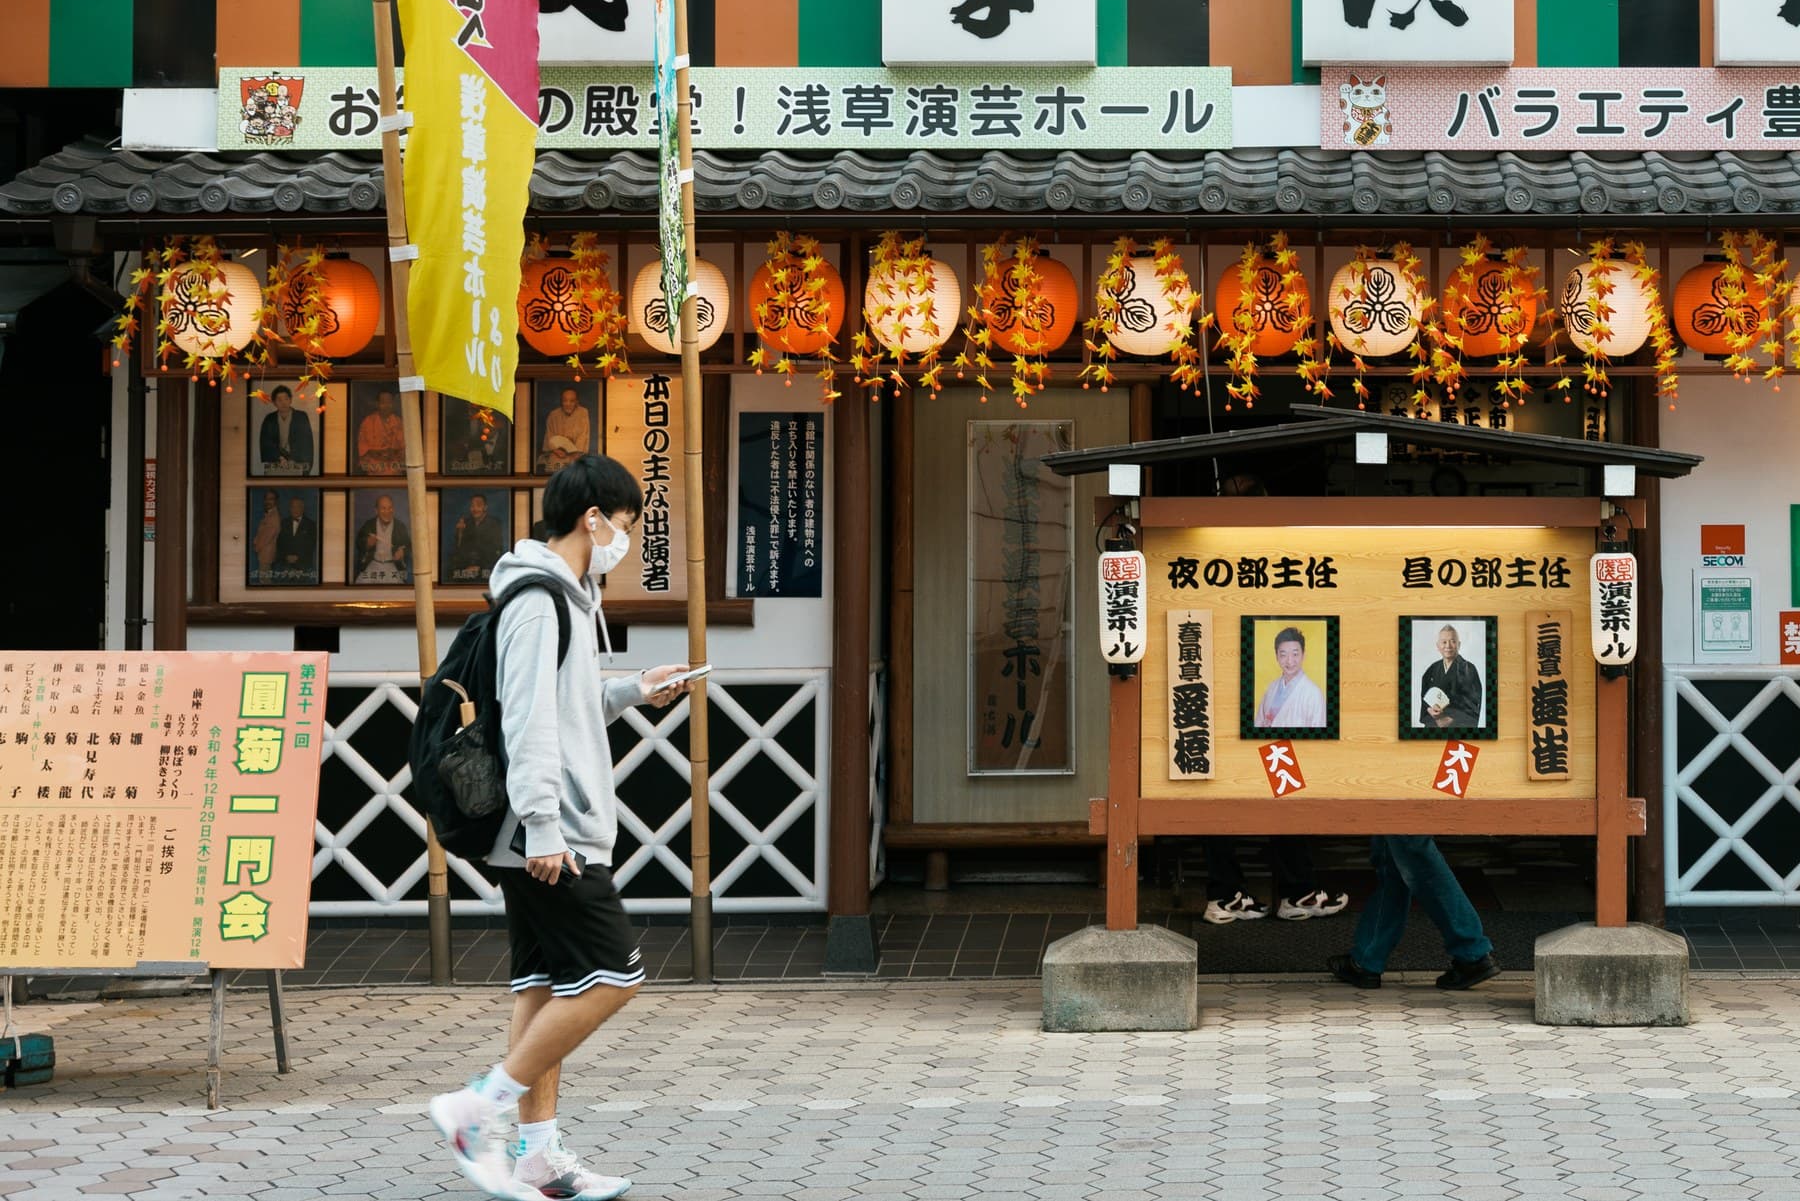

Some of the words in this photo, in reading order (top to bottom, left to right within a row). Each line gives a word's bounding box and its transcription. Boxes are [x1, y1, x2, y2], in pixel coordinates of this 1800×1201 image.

[641, 372, 672, 592] 本日の主な出演者
[788, 420, 798, 542] 立ち入りを禁止いたします。
[804, 420, 815, 567] 当館に関係のない者の建物内への
[745, 526, 755, 592] 浅草演芸ホール
[1168, 557, 1338, 590] 夜の部主任
[1402, 557, 1571, 590] 昼の部主任
[1703, 556, 1743, 566] SECOM
[1104, 580, 1139, 659] 演芸ホール
[1599, 582, 1632, 659] 演芸ホール
[294, 664, 316, 749] 第五十一回
[170, 745, 184, 800] 松ぼっくり
[160, 827, 176, 875] ご挨拶
